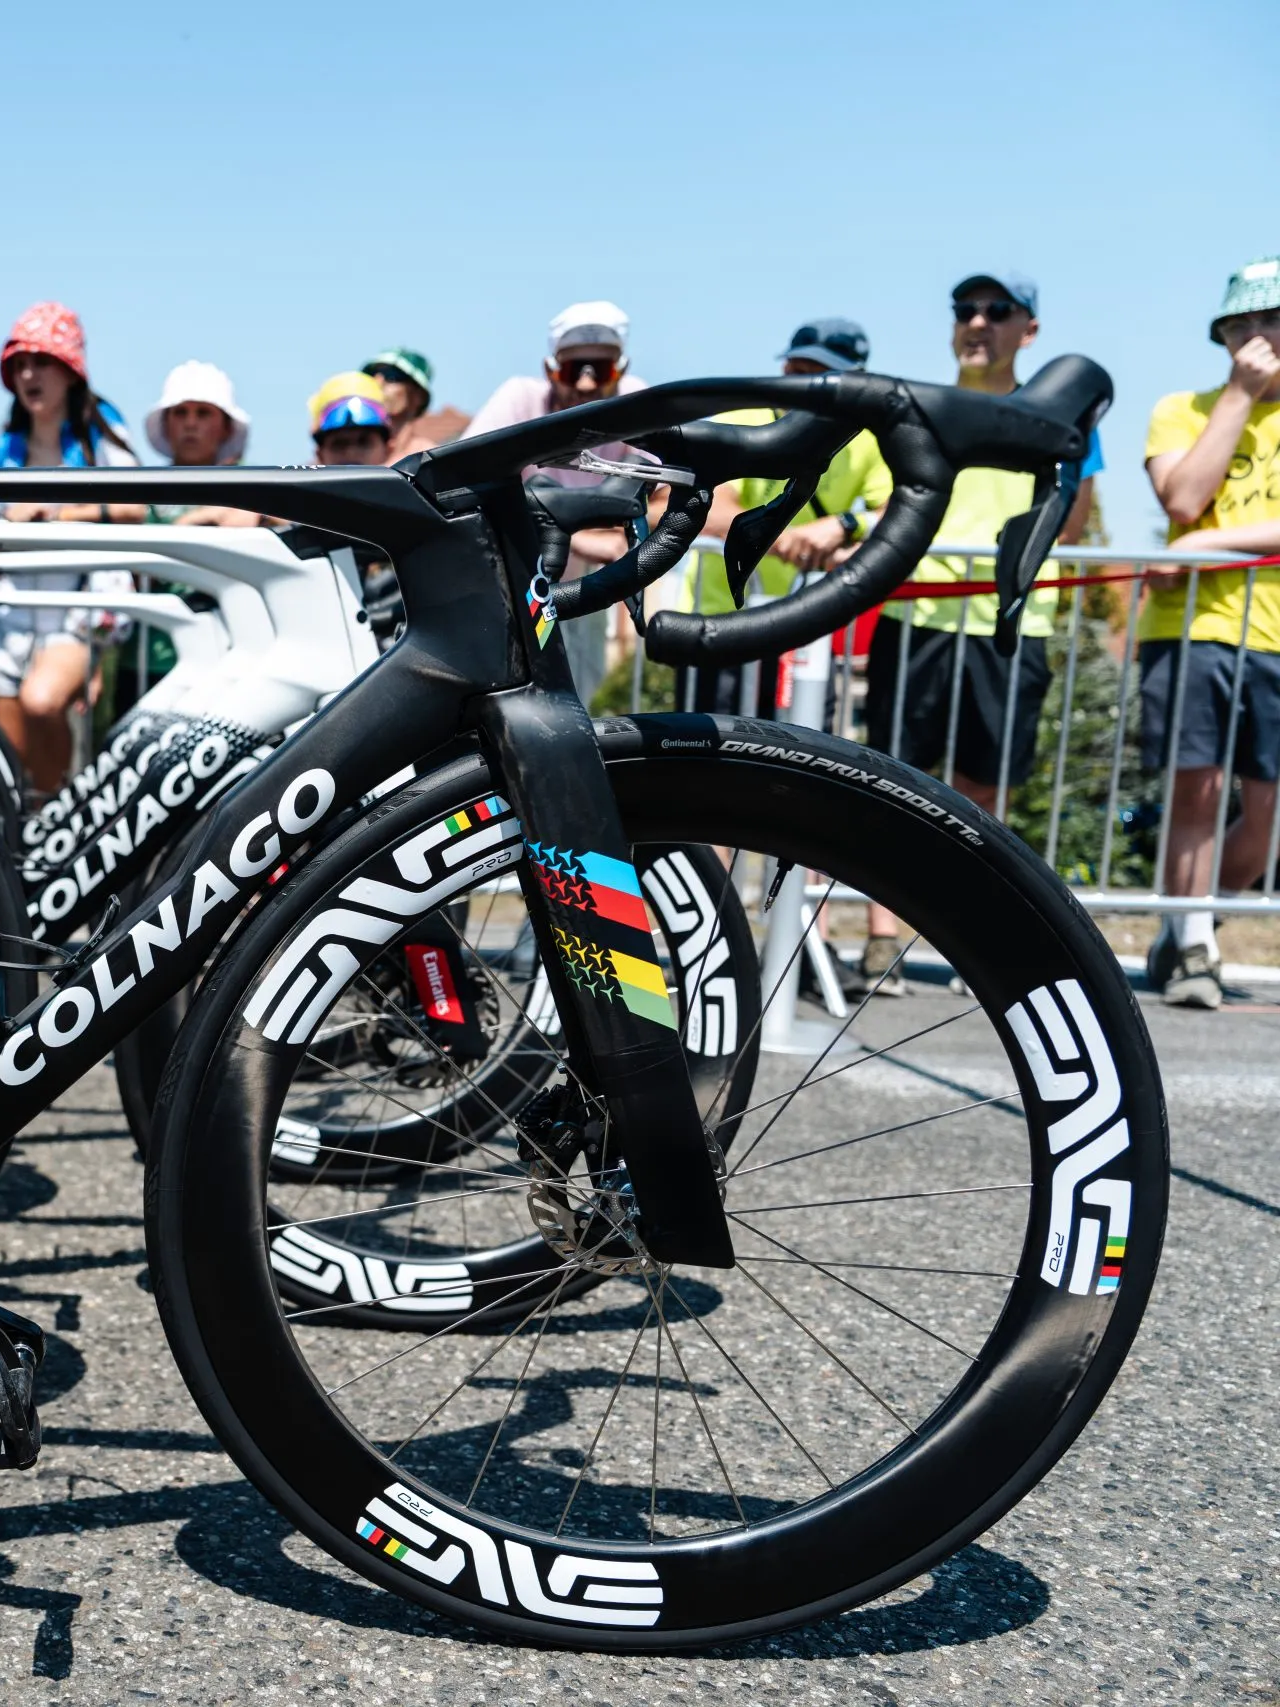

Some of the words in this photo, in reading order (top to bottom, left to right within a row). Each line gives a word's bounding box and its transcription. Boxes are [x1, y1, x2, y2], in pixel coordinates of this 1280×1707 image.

[661, 738, 706, 748] Continental
[719, 739, 810, 764] GRAND
[809, 757, 878, 784] PRIX
[871, 777, 947, 817] 5000
[472, 852, 512, 877] PRO
[423, 951, 450, 1016] Emirates
[1048, 1231, 1065, 1273] PRO
[397, 1492, 434, 1517] PRO
